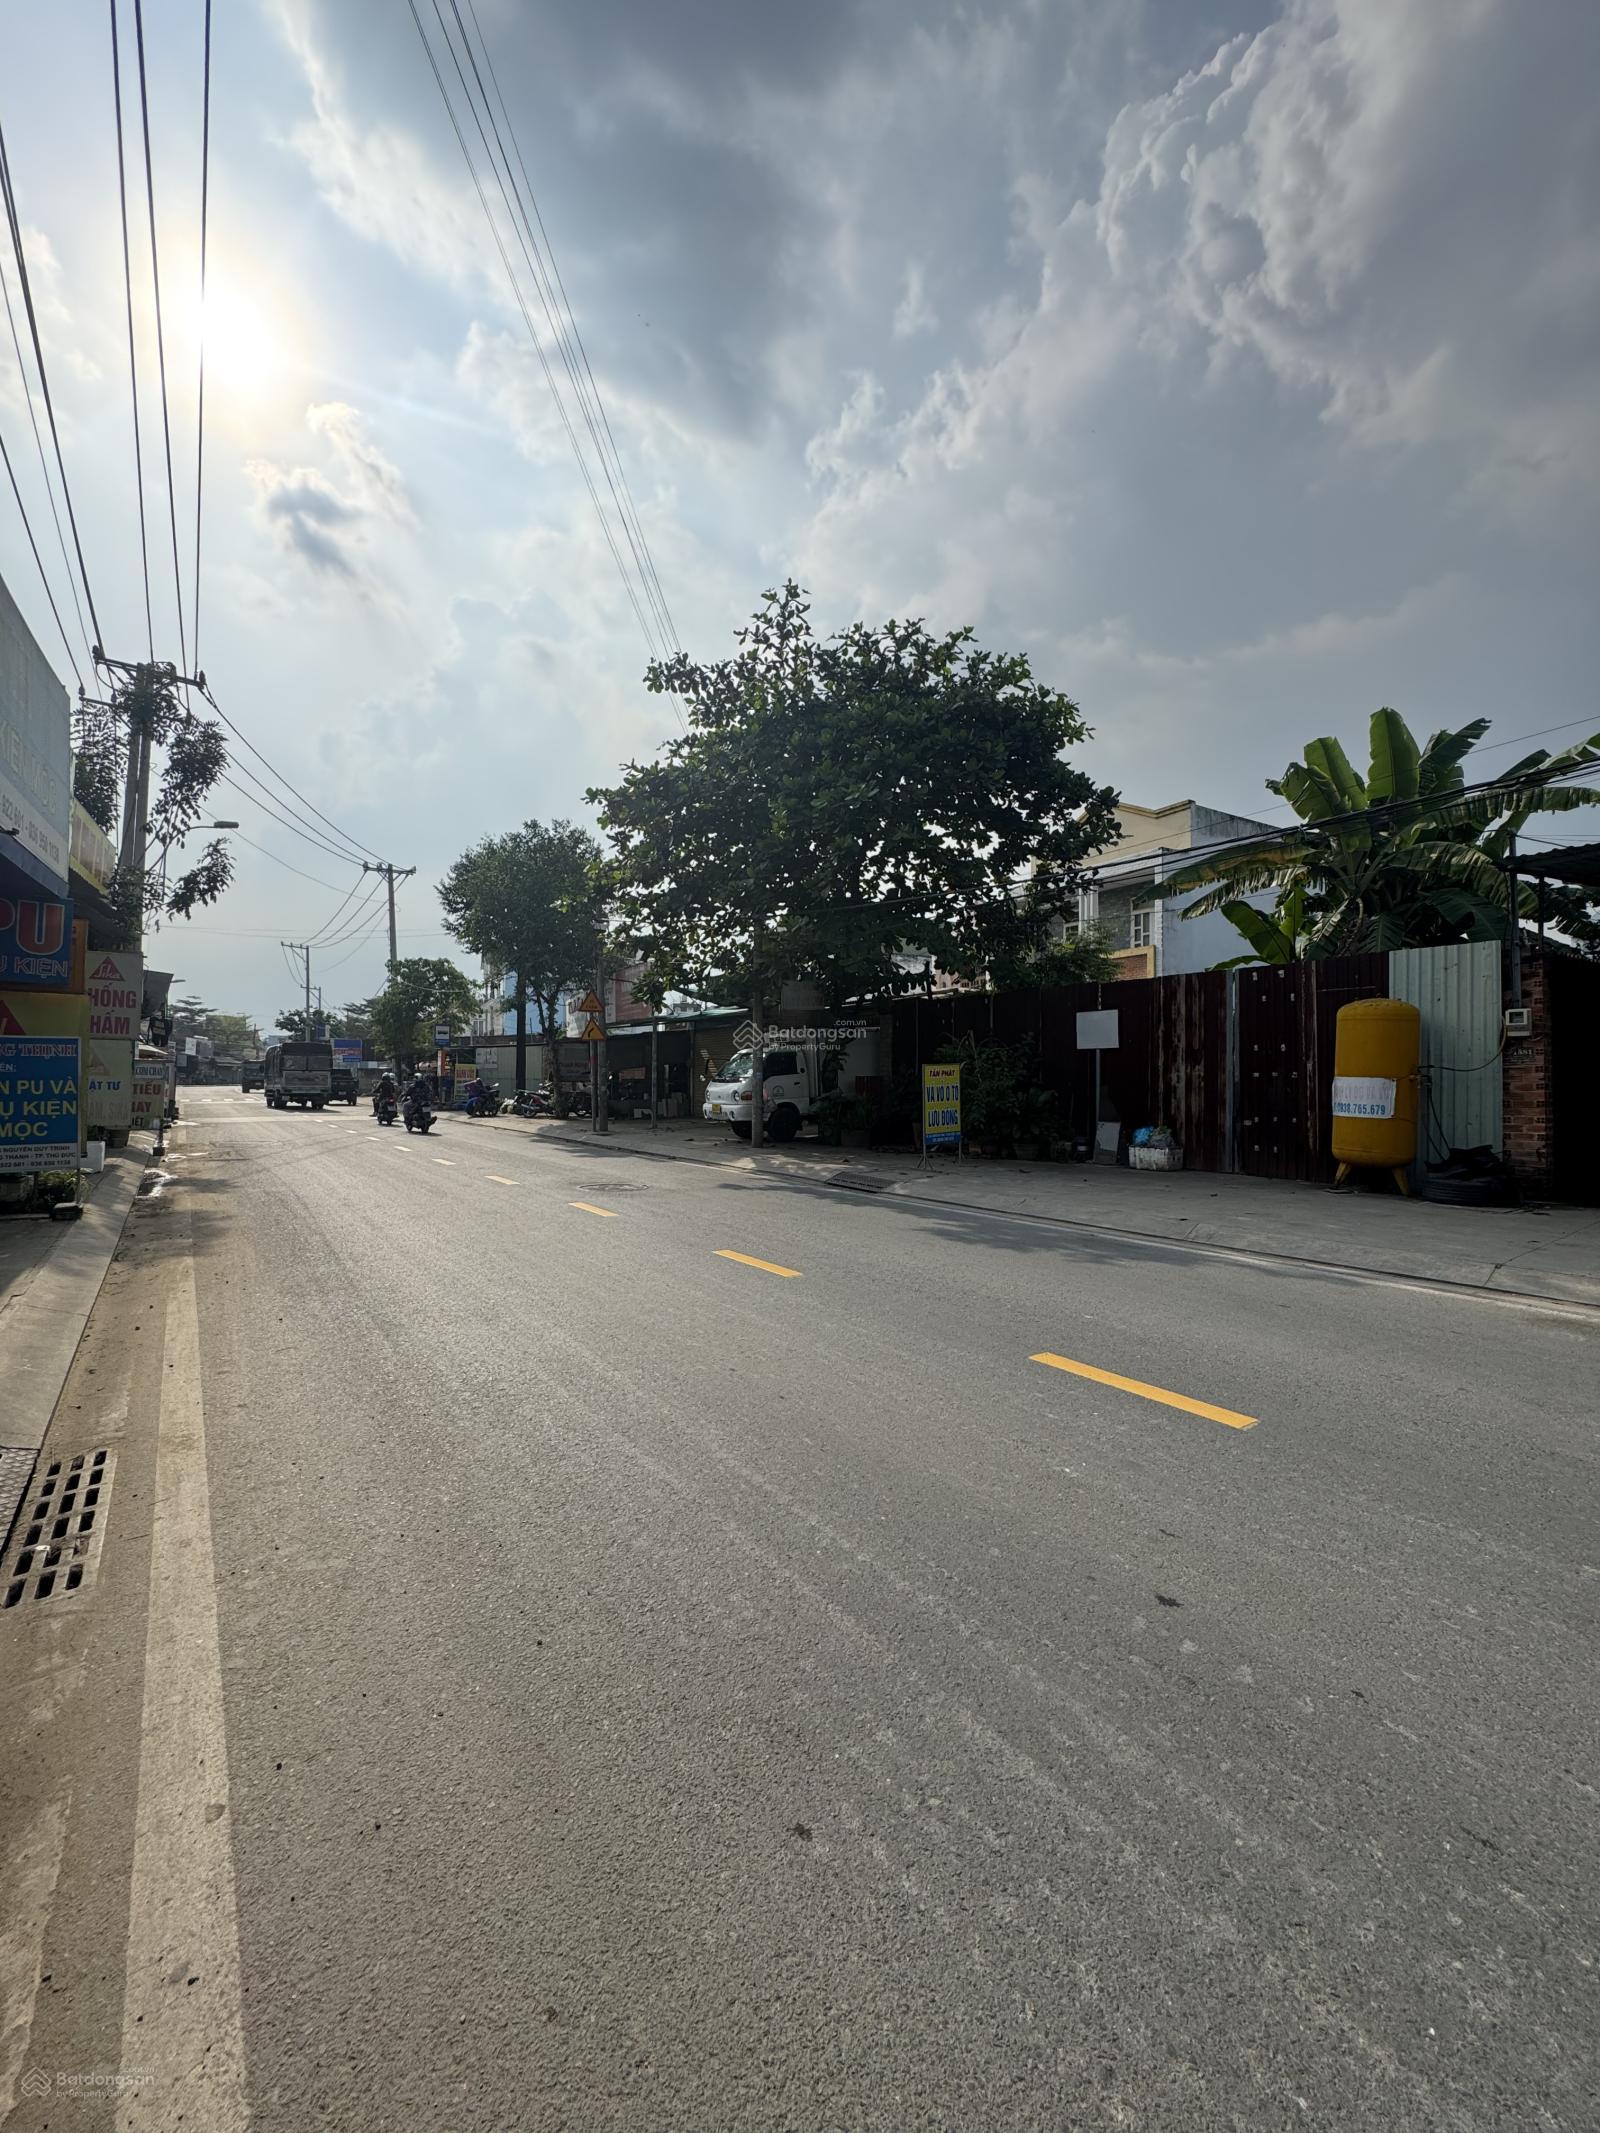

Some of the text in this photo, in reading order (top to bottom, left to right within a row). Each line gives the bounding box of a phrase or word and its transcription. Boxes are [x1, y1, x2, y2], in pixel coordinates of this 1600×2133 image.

[17, 1080, 45, 1094] PU
[50, 1076, 77, 1094] VÀ
[24, 1098, 77, 1119] KIỆN
[0, 1118, 49, 1141] MỘC
